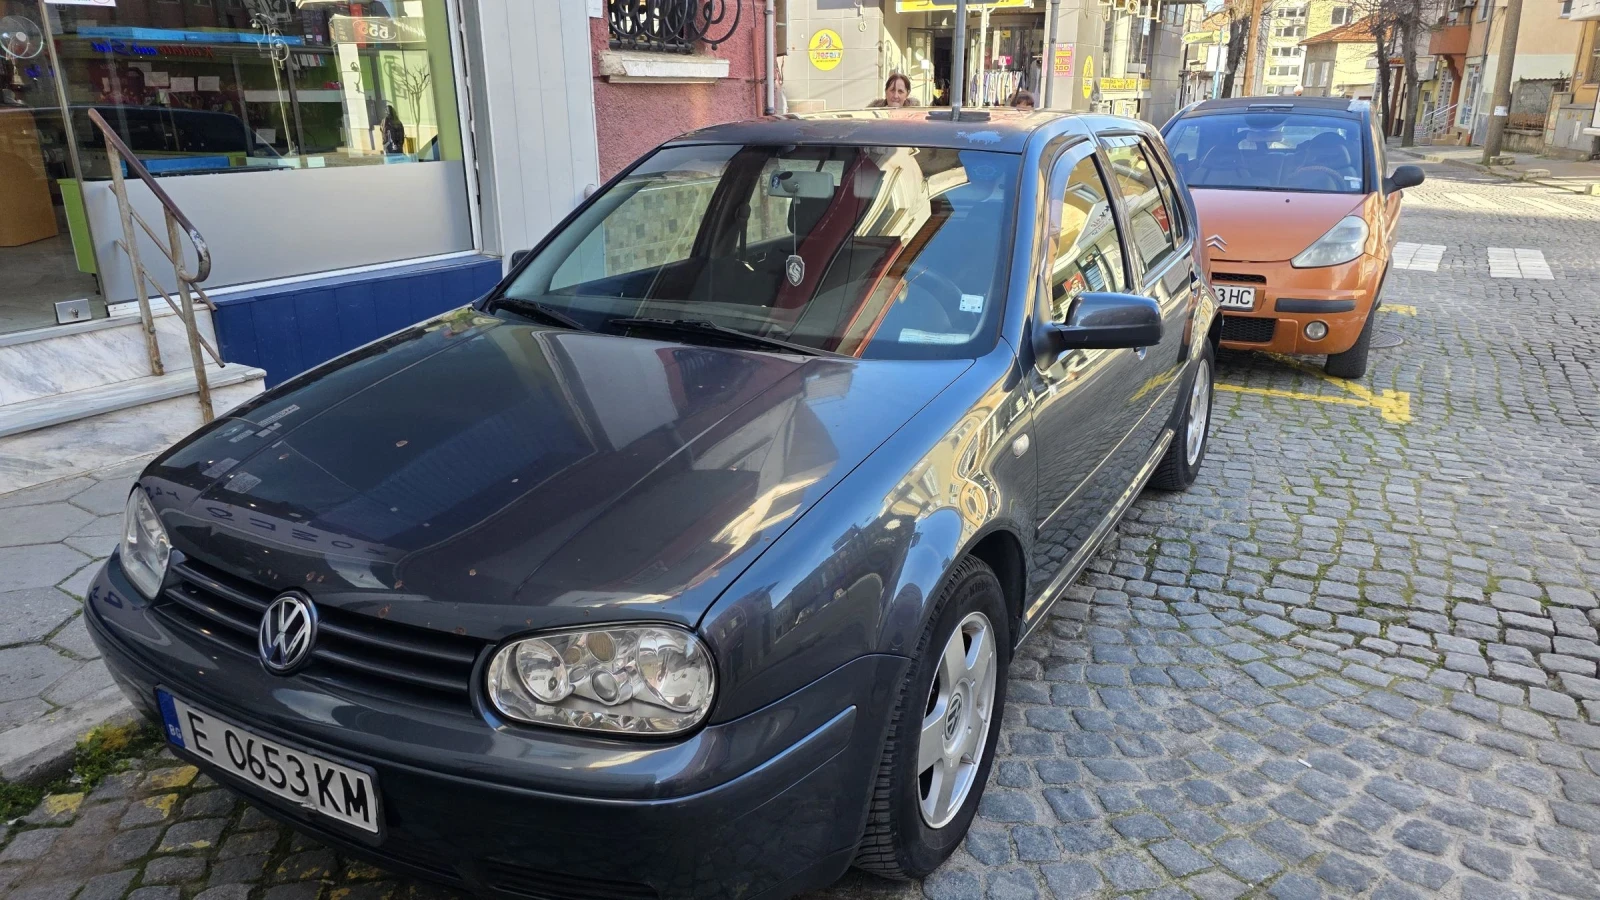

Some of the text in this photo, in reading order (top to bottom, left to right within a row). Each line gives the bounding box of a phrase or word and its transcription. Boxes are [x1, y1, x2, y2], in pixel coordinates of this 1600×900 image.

[1228, 289, 1251, 305] HC
[167, 723, 183, 740] BG
[189, 711, 371, 823] E 0653 KM
